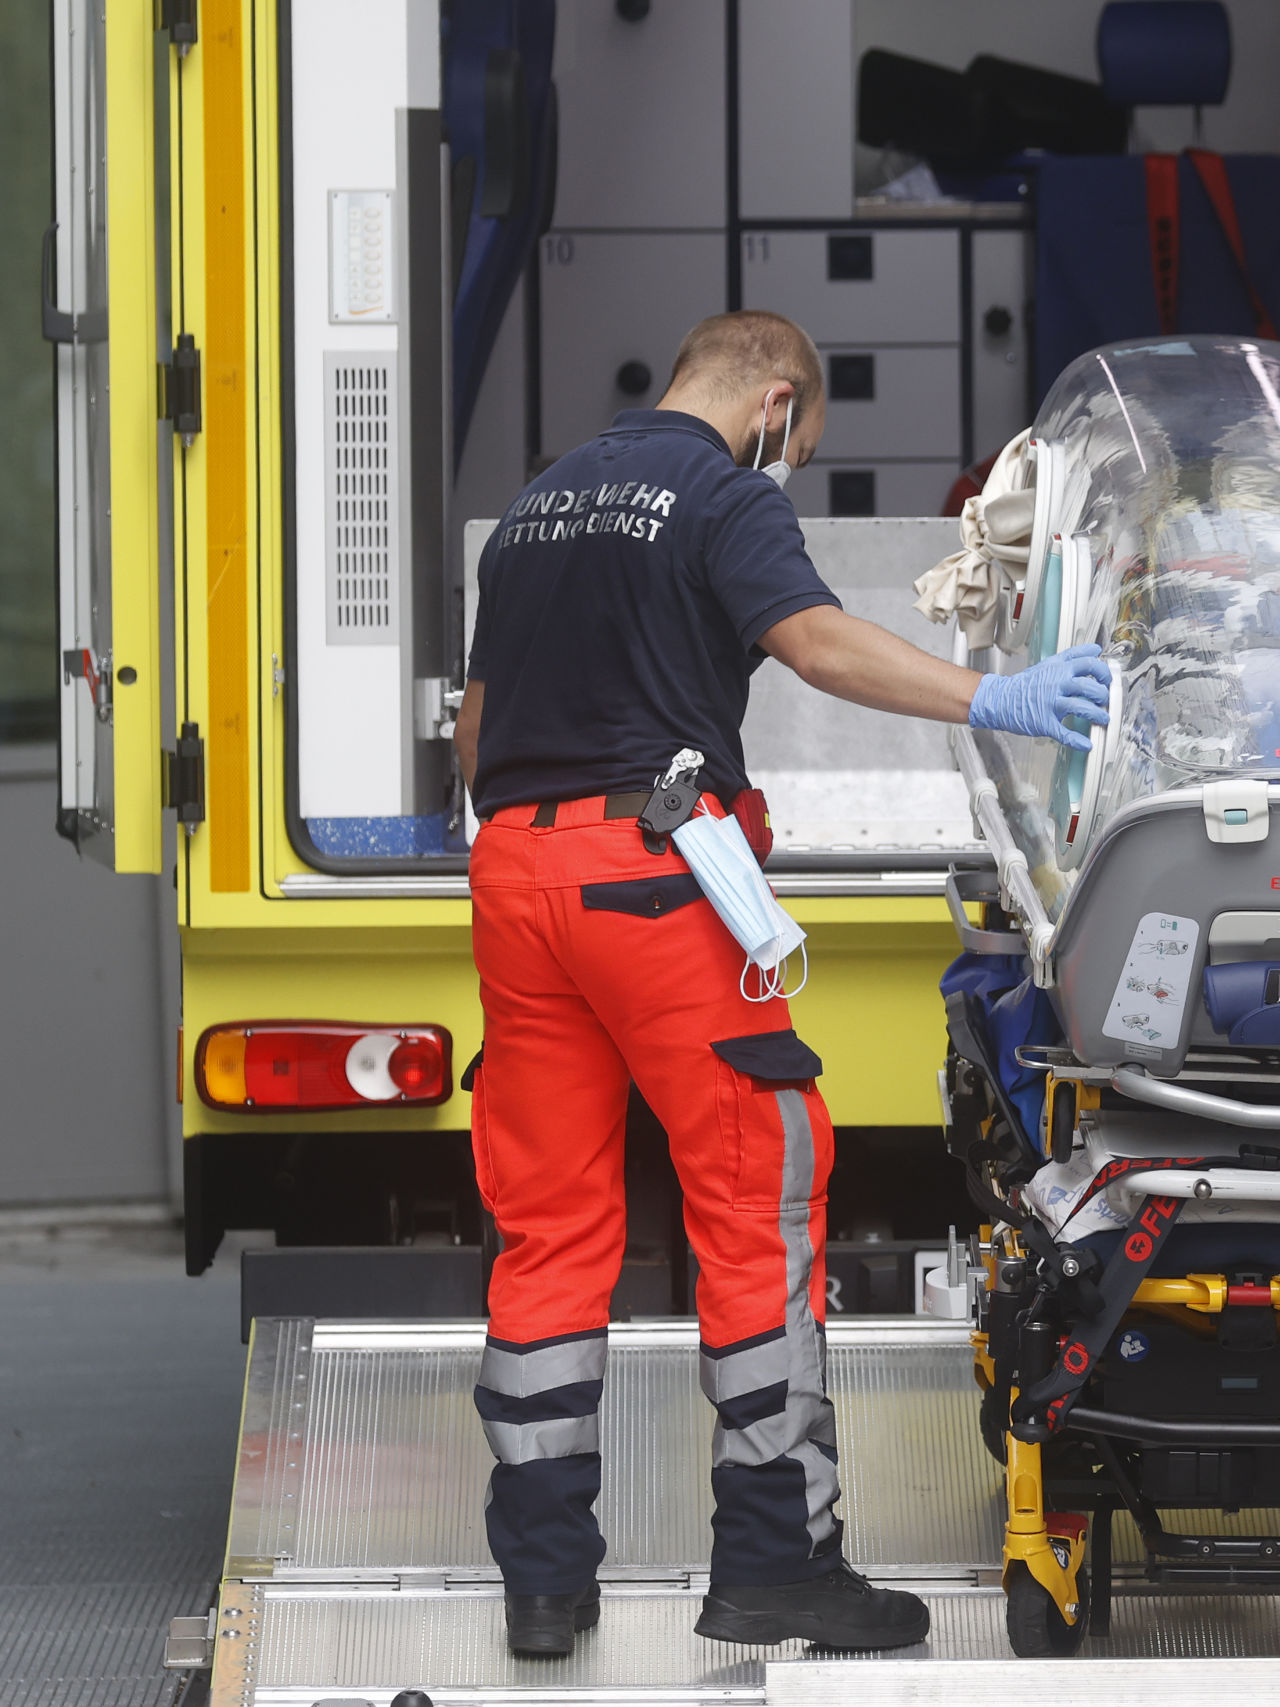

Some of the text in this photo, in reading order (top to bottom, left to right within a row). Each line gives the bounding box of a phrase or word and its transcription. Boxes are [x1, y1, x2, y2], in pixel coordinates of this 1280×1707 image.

[546, 236, 575, 266] 10
[744, 236, 771, 262] 11
[505, 481, 677, 525] UNDEWEHR
